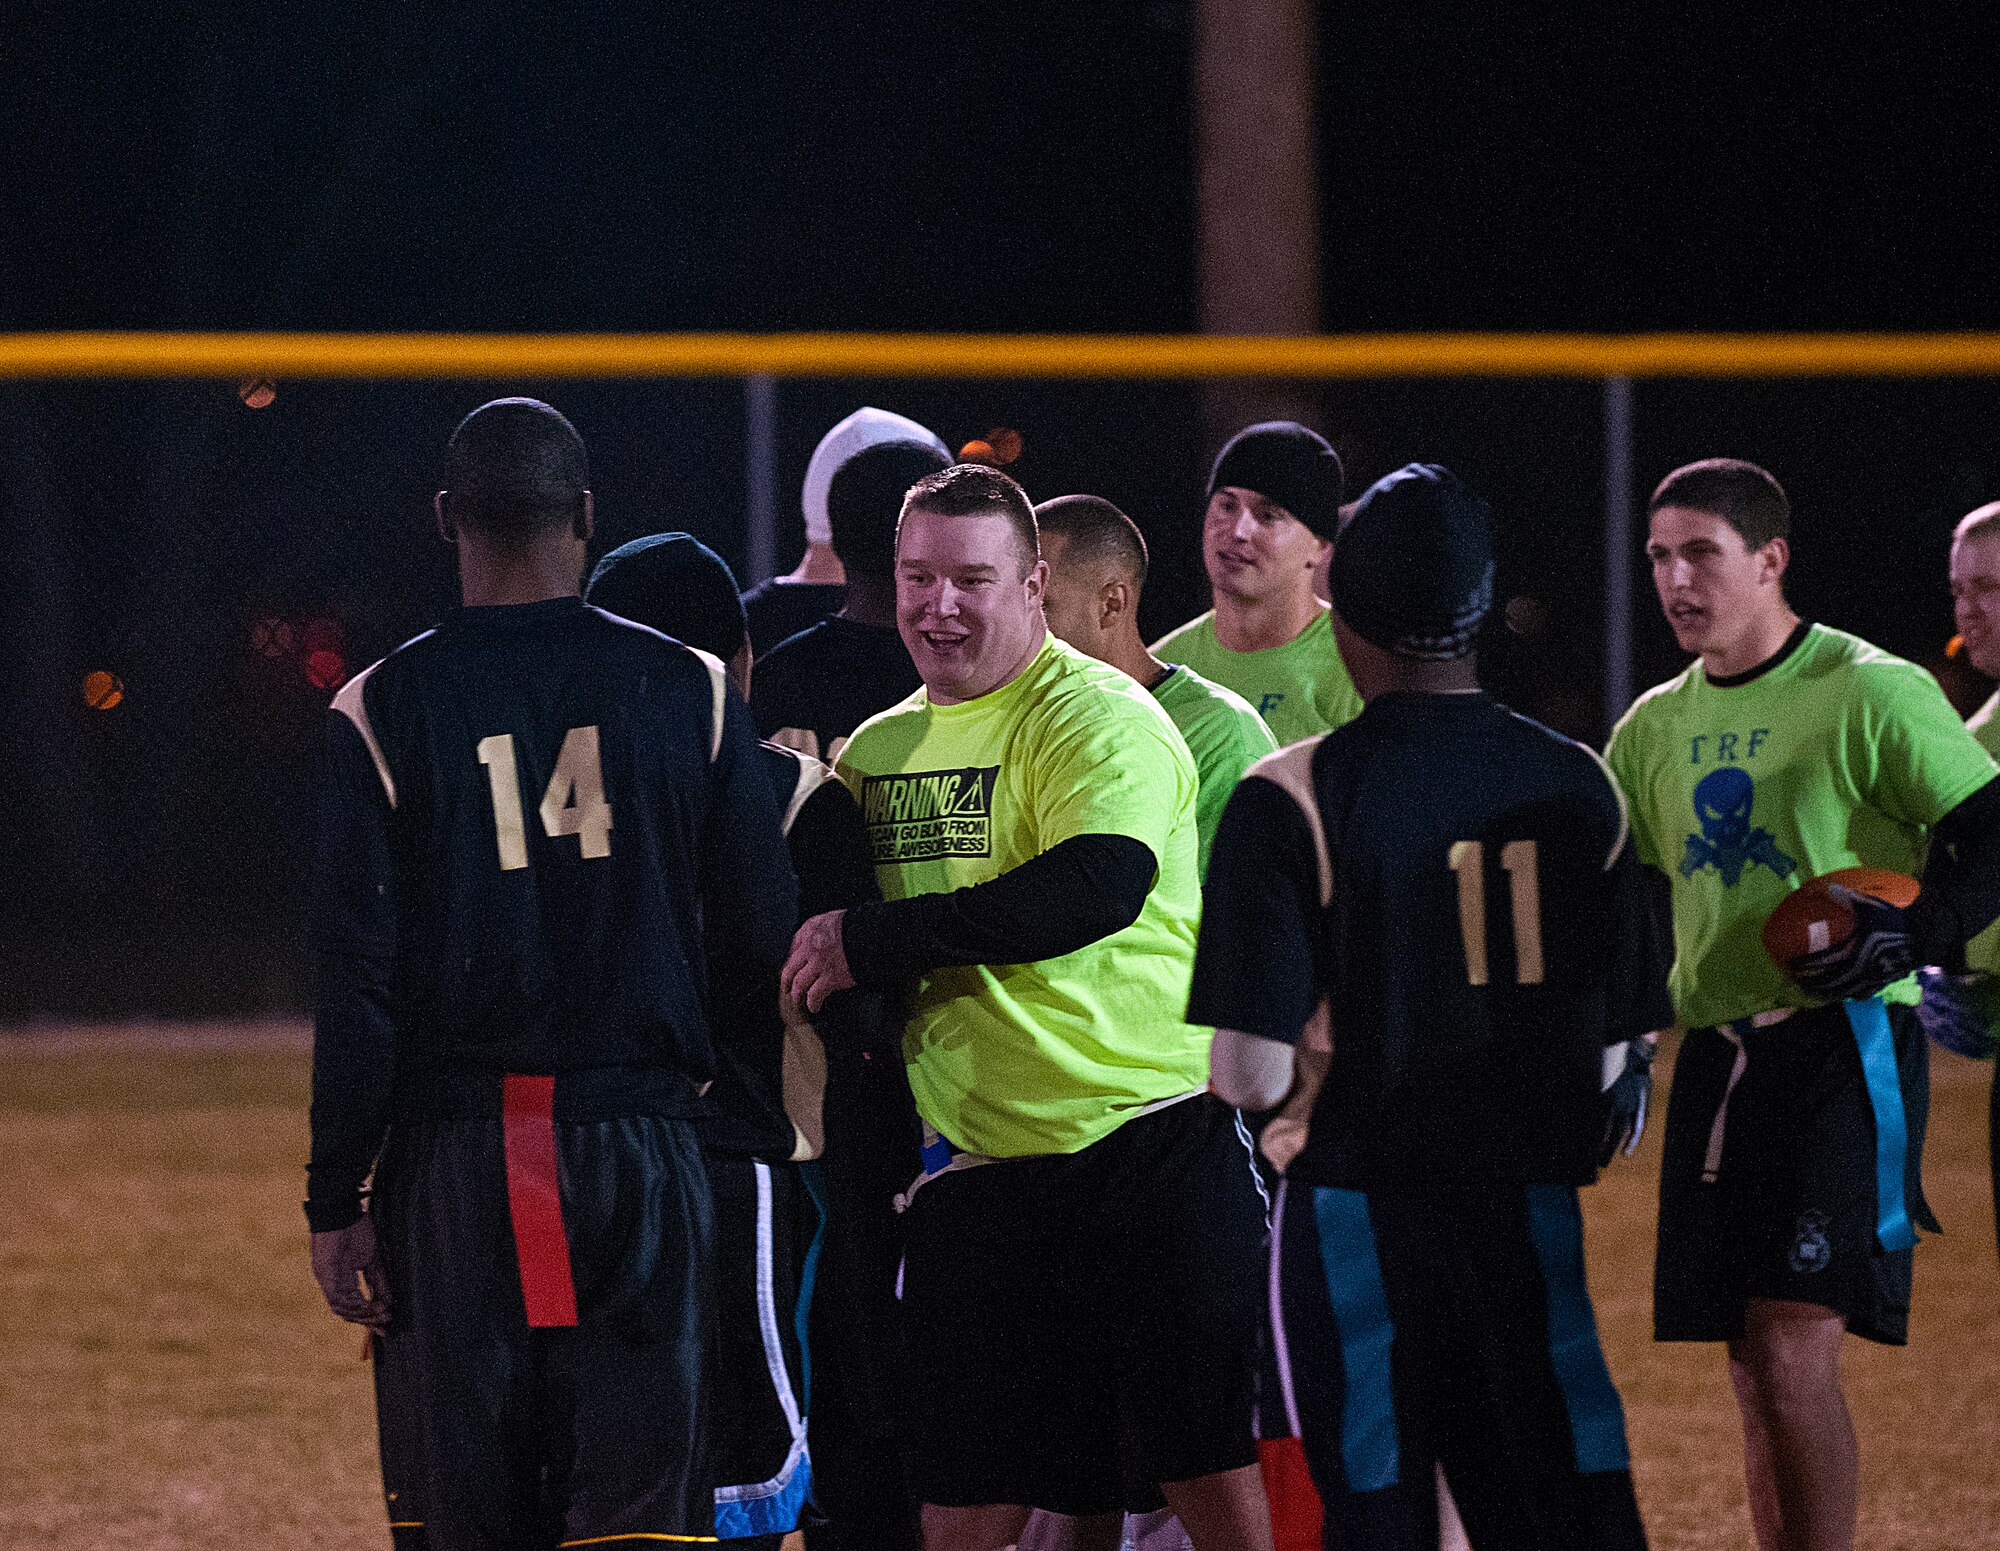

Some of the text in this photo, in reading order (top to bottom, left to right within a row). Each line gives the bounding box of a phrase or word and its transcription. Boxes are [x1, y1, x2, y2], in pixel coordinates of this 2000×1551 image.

[476, 724, 614, 871] 14
[864, 774, 962, 824] WARNING
[901, 824, 919, 841] GO
[948, 820, 986, 835] FROM
[1449, 839, 1544, 986] 11
